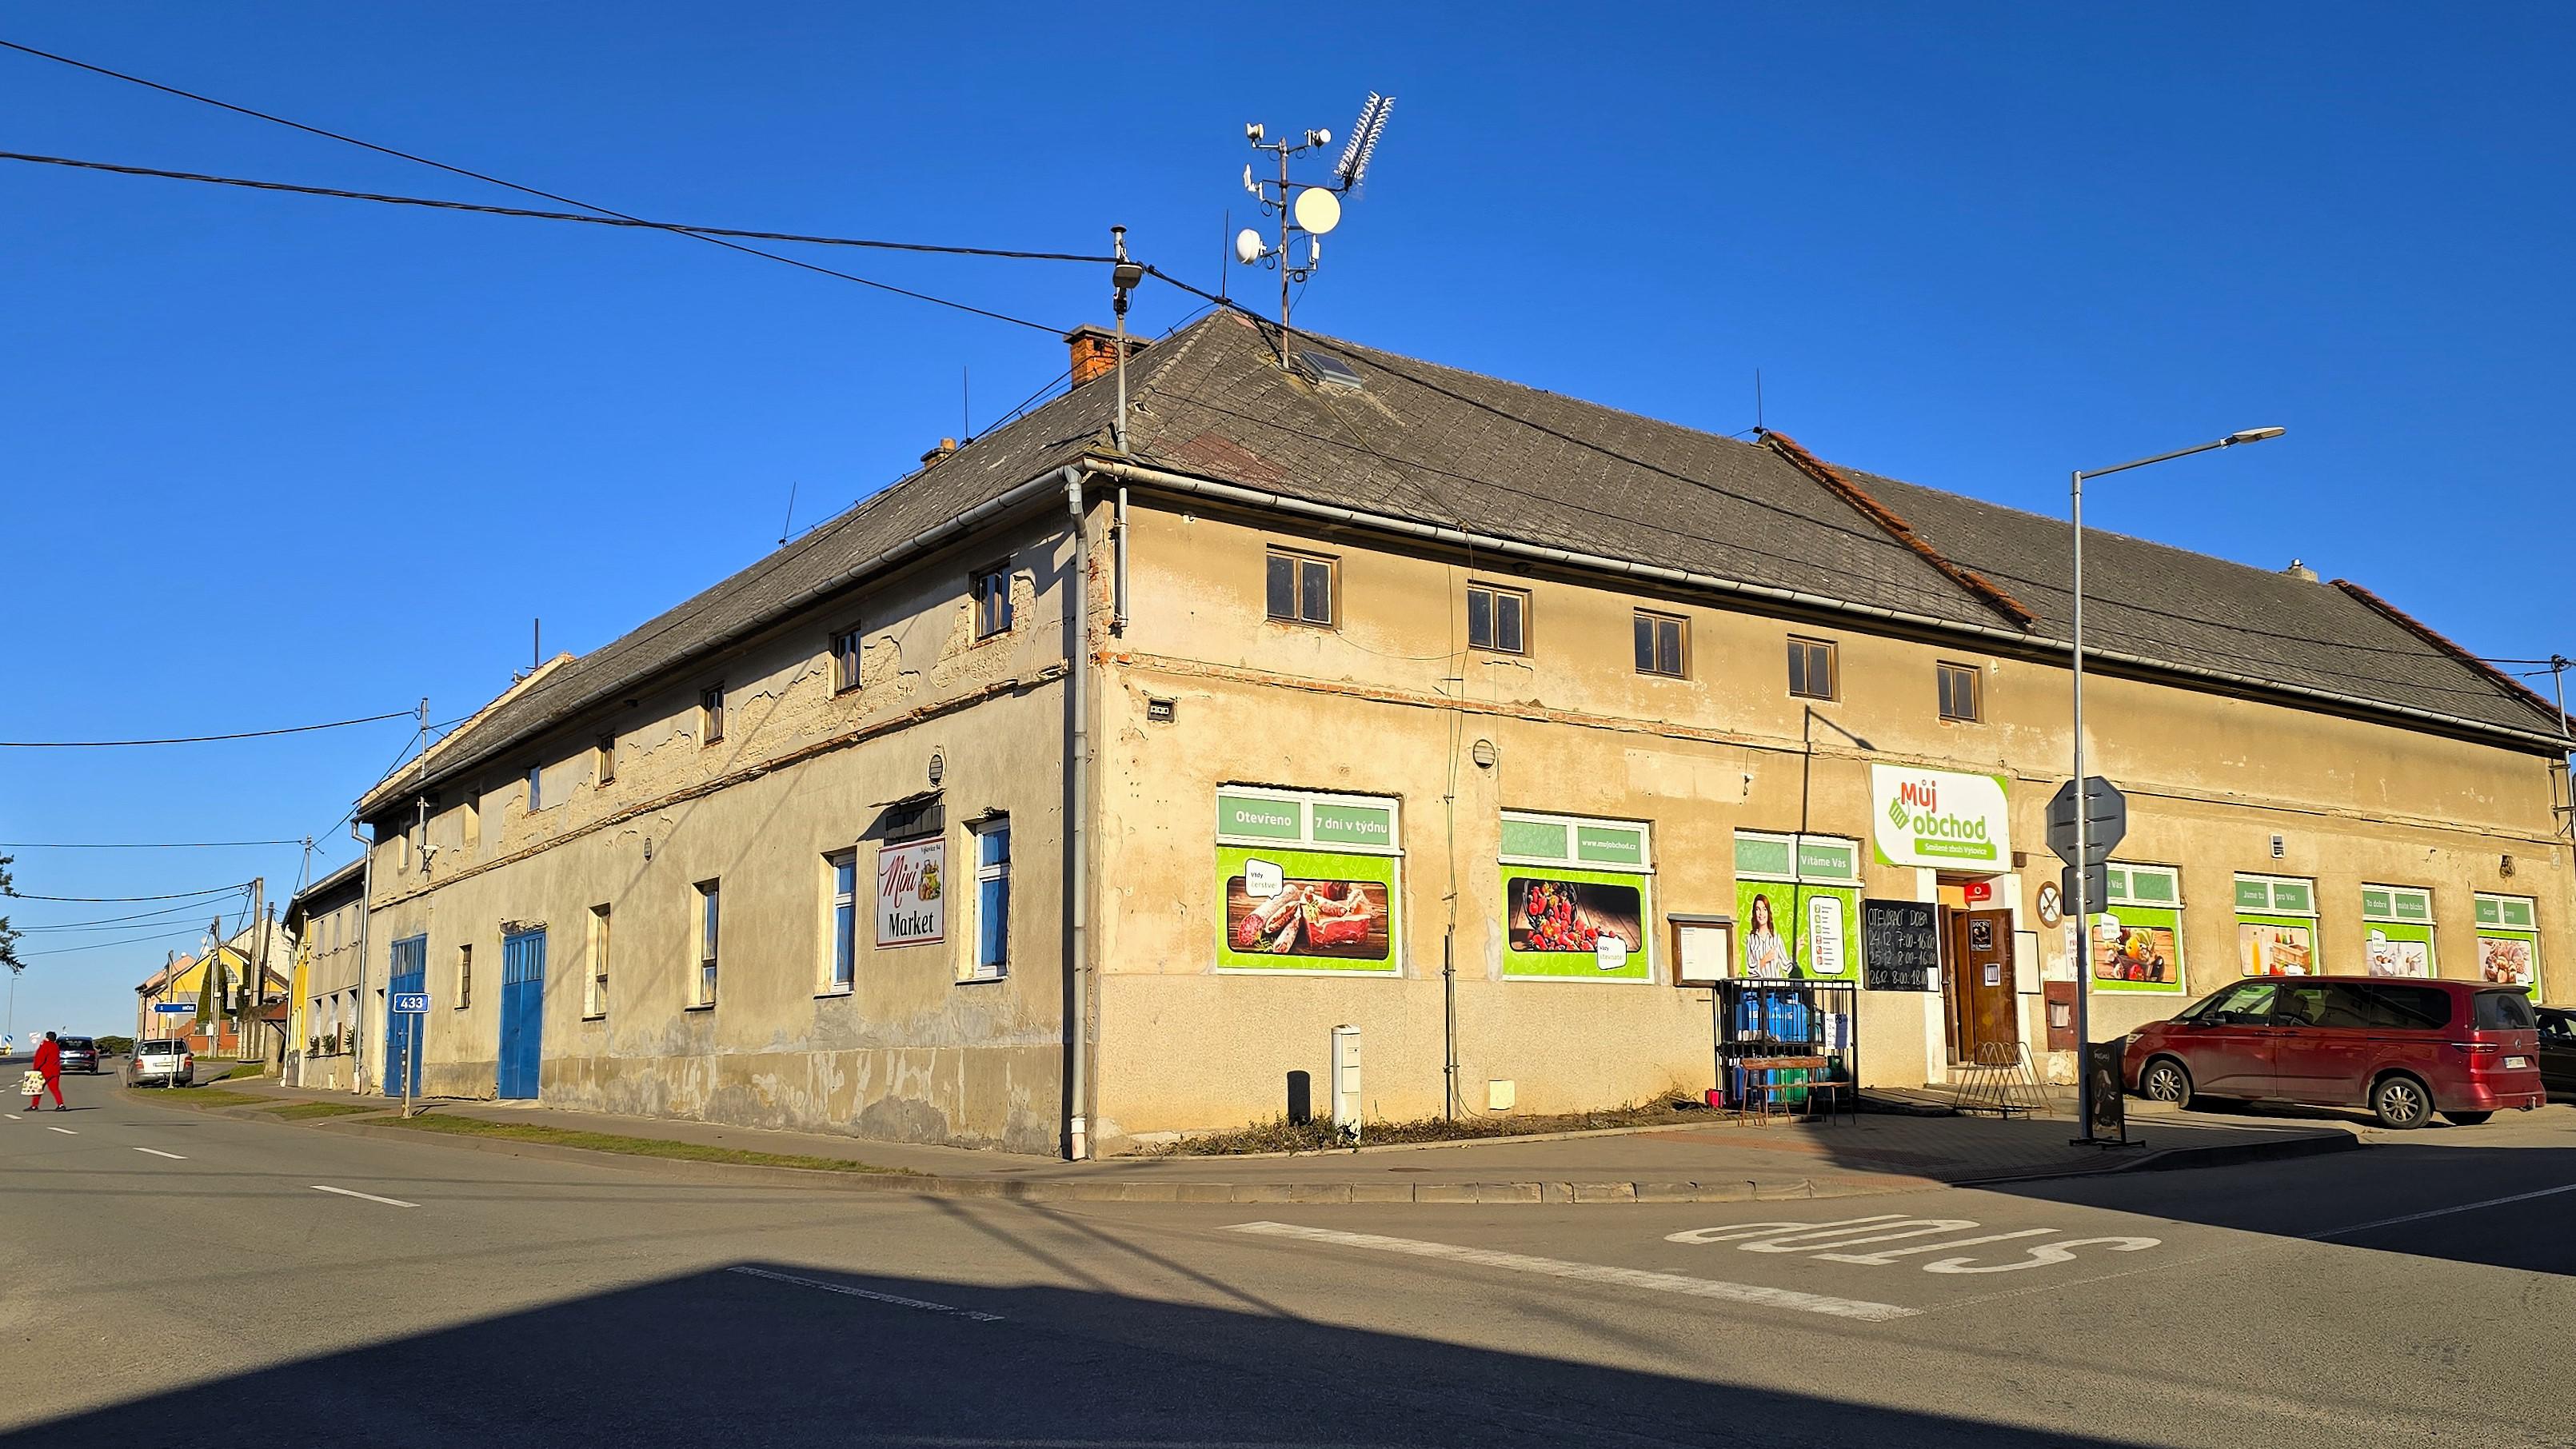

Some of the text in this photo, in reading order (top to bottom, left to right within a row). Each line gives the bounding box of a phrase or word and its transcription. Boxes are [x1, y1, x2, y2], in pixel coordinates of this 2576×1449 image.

[1901, 779, 1937, 814] Můj
[1236, 810, 1388, 835] Otevřeno 7 dní v týdnu
[1913, 811, 1987, 840] obchod
[1800, 855, 1847, 868] Vítáme Vás
[880, 855, 920, 909] Mini
[889, 910, 934, 938] Market
[1910, 909, 1928, 927] DOBA
[400, 996, 423, 1009] 433
[1663, 1214, 2162, 1274] STOP
